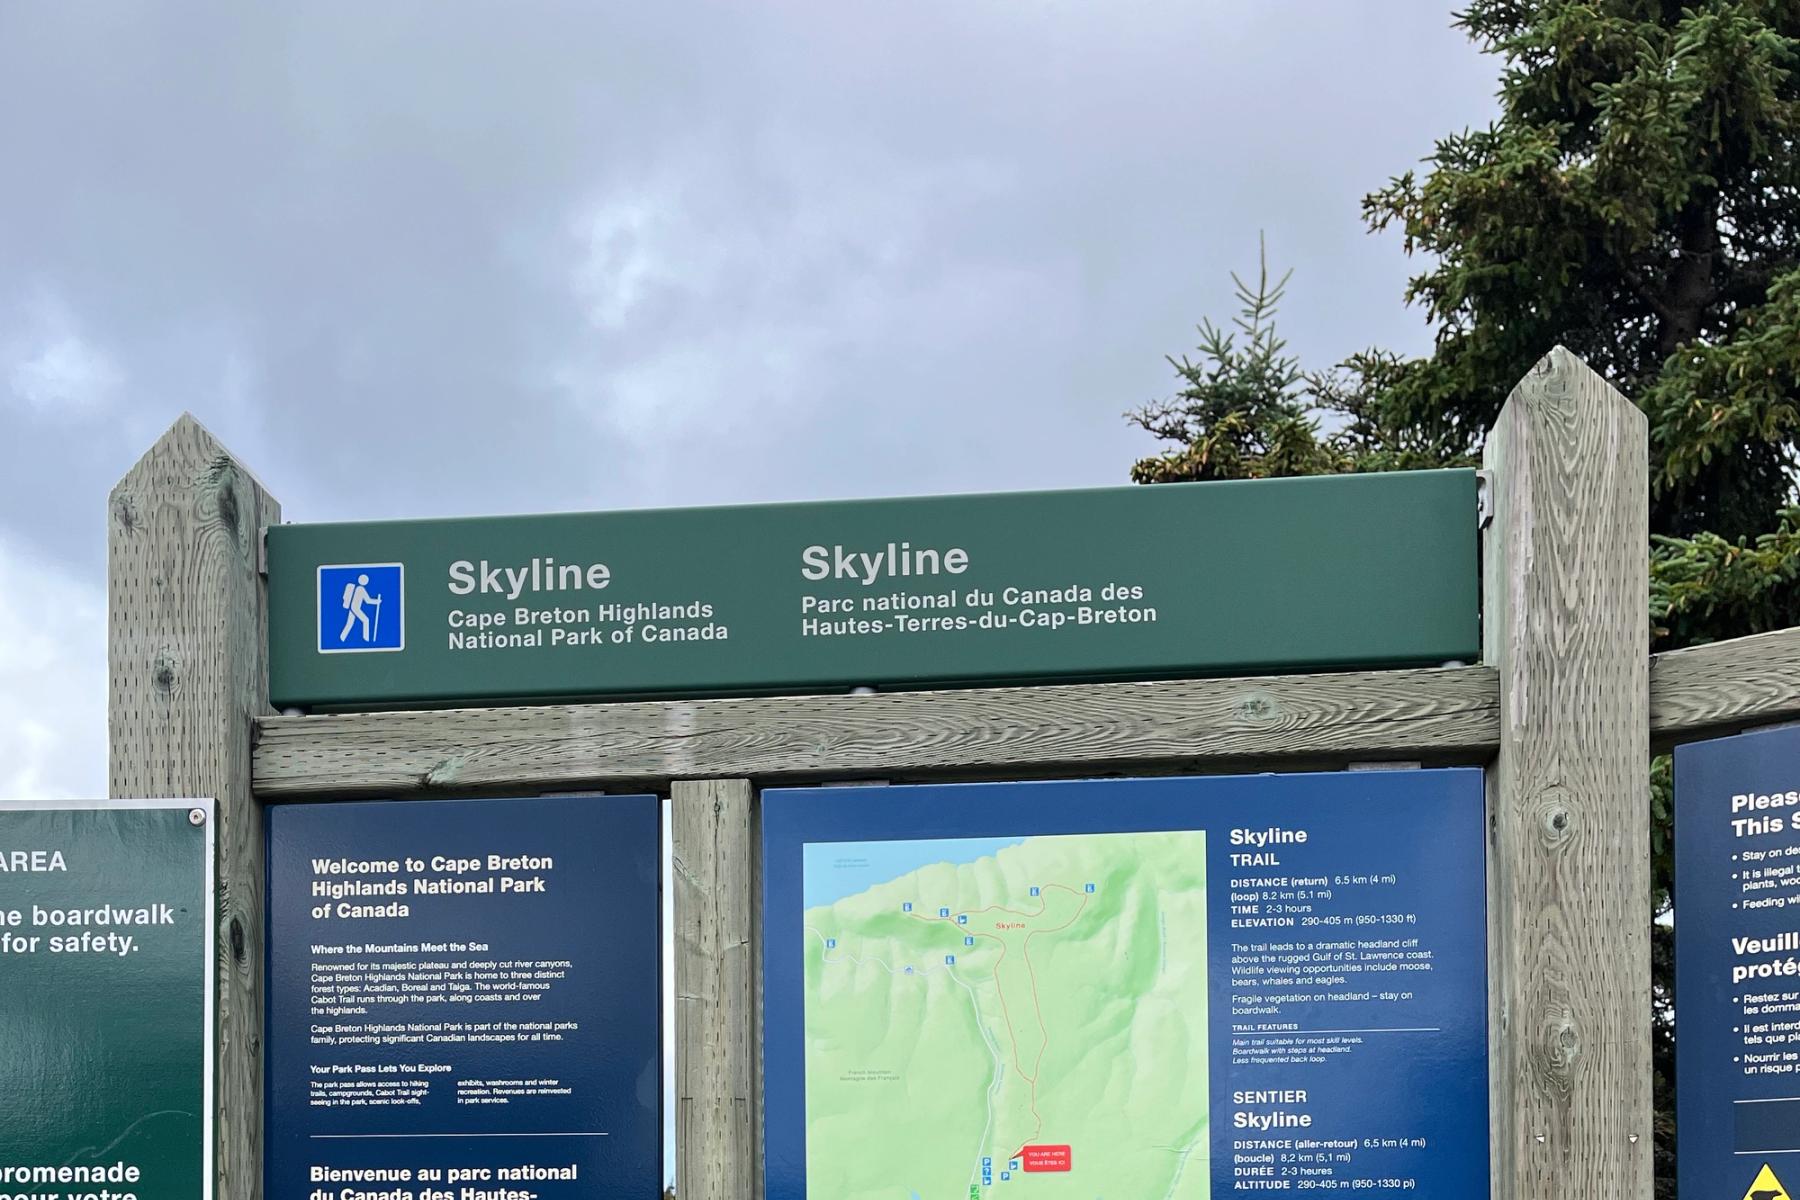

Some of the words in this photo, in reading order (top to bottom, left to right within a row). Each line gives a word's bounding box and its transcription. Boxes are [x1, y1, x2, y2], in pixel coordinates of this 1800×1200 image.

[801, 541, 968, 585] Skyline
[448, 557, 610, 599] Skyline
[802, 596, 853, 613] Parc
[863, 590, 955, 610] national
[966, 589, 993, 606] du
[1003, 584, 1091, 605] Canada
[1101, 583, 1142, 600] des
[448, 610, 505, 629] Cape
[515, 607, 589, 624] Breton
[599, 601, 712, 623] Highlands
[803, 606, 1156, 635] Hautes-Terres-du-Cap-Breton
[449, 627, 541, 649] National
[552, 627, 602, 645] Park
[611, 623, 633, 643] of
[642, 622, 727, 642] Canada
[1732, 791, 1800, 813] Pleas
[1731, 816, 1783, 837] This
[1230, 827, 1307, 847] Skyline
[1230, 853, 1279, 866] TRAIL
[1742, 850, 1766, 861] Stay
[1769, 849, 1782, 858] on
[1785, 846, 1800, 856] de
[311, 858, 399, 874] Welcome
[405, 857, 424, 871] to
[431, 856, 480, 874] Cape
[487, 855, 552, 870] Breton
[1742, 870, 1749, 879] It
[1752, 869, 1761, 878] is
[1764, 865, 1794, 877] illegal
[1230, 877, 1287, 887] DISTANCE
[1291, 876, 1327, 887] (return)
[1335, 875, 1349, 884] 6.5
[1352, 875, 1366, 883] km
[1370, 875, 1378, 884] (4
[1381, 874, 1395, 884] mi)
[1742, 879, 1778, 892] plants,
[312, 879, 407, 899] Highlands
[414, 877, 493, 894] National
[501, 876, 545, 892] Park
[1231, 891, 1258, 902] (loop)
[1262, 891, 1276, 900] 8.2
[1280, 891, 1294, 899] km
[1297, 890, 1312, 900] (5.1
[1317, 889, 1331, 899] mi)
[311, 903, 331, 918] of
[337, 901, 408, 918] Canada
[1230, 905, 1258, 914] TIME
[1266, 904, 1282, 913] 2-3
[1285, 904, 1311, 912] hours
[1743, 897, 1784, 909] Feeding
[33, 904, 175, 926] boardwalk
[1231, 917, 1293, 927] ELEVATION
[1301, 916, 1340, 925] 290-405
[1355, 914, 1403, 925] (950-1330
[1406, 914, 1416, 924] ft)
[996, 922, 1026, 930] Skyline
[1, 932, 41, 953] for
[49, 931, 139, 957] safety.
[311, 945, 343, 953] Where
[345, 944, 362, 953] the
[365, 943, 418, 952] Mountains
[421, 942, 447, 952] Meet
[449, 942, 466, 951] the
[469, 942, 488, 951] Sea
[1231, 943, 1248, 951] The
[1250, 943, 1267, 951] trail
[1270, 942, 1293, 951] leads
[1296, 942, 1305, 950] to
[1315, 940, 1355, 949] dramatic
[1358, 939, 1399, 948] headland
[1402, 938, 1418, 947] cliff
[1732, 932, 1800, 955] Veuill
[311, 963, 355, 971] Renowned
[357, 962, 368, 970] for
[370, 962, 380, 970] its
[382, 962, 416, 971] majestic
[418, 961, 449, 971] plateau
[451, 960, 467, 968] and
[469, 960, 497, 969] deeply
[499, 960, 512, 968] cut
[535, 961, 572, 969] canyons,
[1732, 957, 1800, 984] proté
[1743, 994, 1779, 1003] Restez
[1782, 992, 1799, 1001] sur
[1744, 1005, 1759, 1015] les
[1752, 1023, 1768, 1033] est
[1744, 1034, 1763, 1045] tels
[1765, 1034, 1785, 1044] que
[1744, 1053, 1780, 1063] Nourrir
[1783, 1051, 1798, 1061] les
[310, 1065, 330, 1073] Your
[332, 1065, 352, 1073] Park
[354, 1064, 376, 1072] Pass
[378, 1064, 397, 1072] Lets
[399, 1064, 416, 1072] You
[418, 1064, 451, 1073] Explore
[1744, 1066, 1758, 1074] un
[1760, 1063, 1793, 1074] risque
[1233, 1090, 1306, 1103] SENTIER
[1233, 1111, 1311, 1130] Skyline
[1234, 1140, 1291, 1149] DISTANCE
[1295, 1139, 1357, 1149] (aller-retour)
[1364, 1138, 1379, 1148] 6,5
[1382, 1138, 1396, 1146] km
[1399, 1138, 1407, 1148] (4
[1411, 1138, 1425, 1148] mi)
[1234, 1153, 1274, 1164] (boucle)
[1280, 1153, 1295, 1163] 8,2
[1298, 1153, 1312, 1161] km
[1315, 1153, 1331, 1163] (5,1
[1336, 1152, 1350, 1163] mi)
[0, 1161, 140, 1183] romenade
[310, 1166, 411, 1181] Bienvenue
[417, 1169, 440, 1180] au
[448, 1168, 491, 1183] parc
[498, 1164, 576, 1180] national
[1234, 1165, 1273, 1175] DURÉE
[1281, 1167, 1297, 1175] 2-3
[1300, 1167, 1332, 1175] heures
[1234, 1180, 1289, 1189] ALTITUDE
[1297, 1179, 1337, 1188] 290-405
[1352, 1179, 1400, 1189] (950-1330
[1403, 1178, 1414, 1189] pi)
